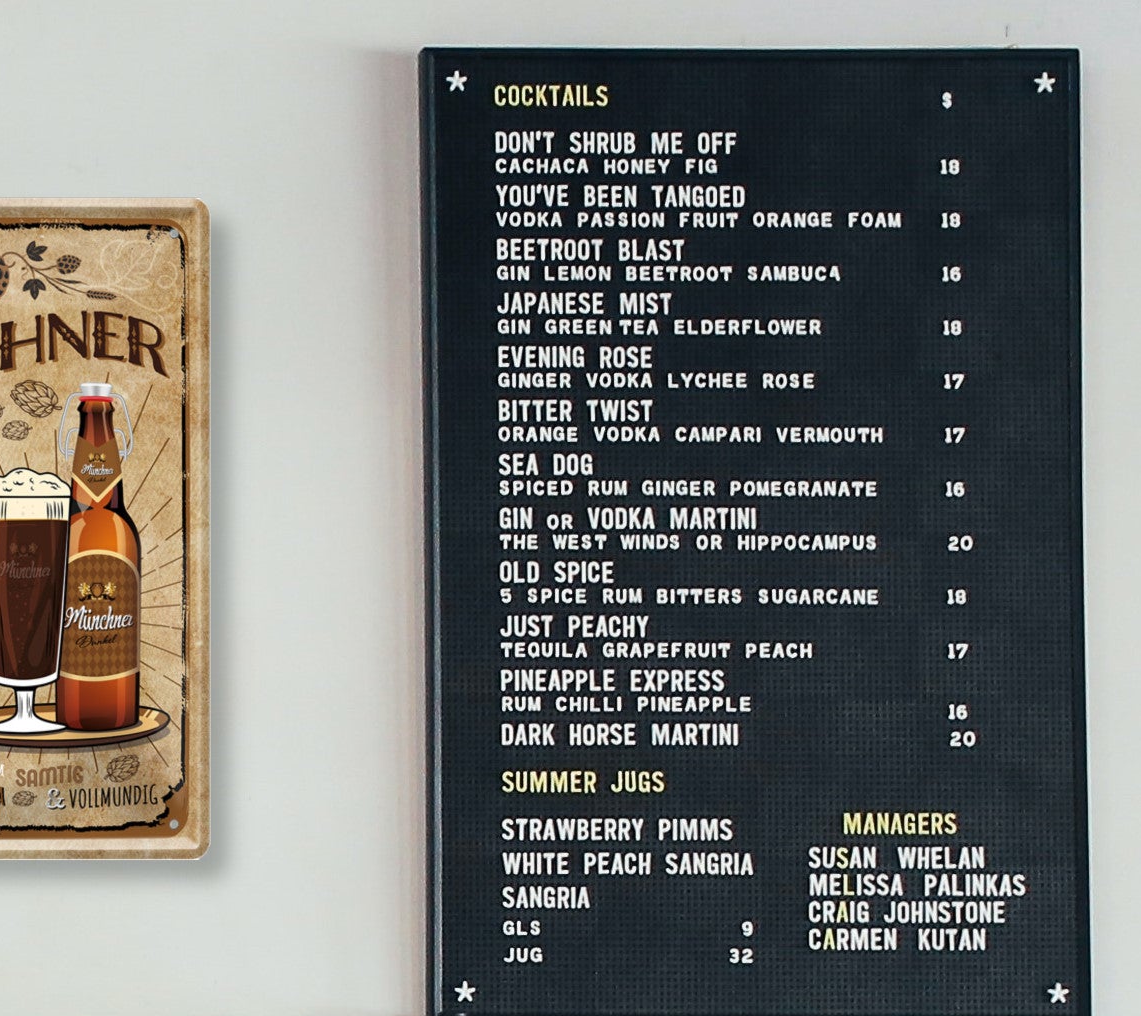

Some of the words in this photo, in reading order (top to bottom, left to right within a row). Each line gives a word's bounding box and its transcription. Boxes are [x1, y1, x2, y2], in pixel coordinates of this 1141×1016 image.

[494, 84, 609, 107] COCKTAILS
[494, 130, 555, 154] DON'T
[569, 131, 636, 155] SHRUB
[650, 131, 683, 155] ME
[697, 131, 737, 155] OFF
[495, 157, 589, 175] CACHACA
[603, 158, 671, 175] HONEY
[685, 158, 718, 175] FIG
[940, 158, 960, 175] 18
[495, 183, 569, 208] YOU'VE
[583, 184, 638, 208] BEEN
[650, 184, 746, 209] TANGOED
[495, 211, 563, 228] VODKA
[577, 211, 665, 229] PASSION
[679, 211, 739, 229] FRUIT
[752, 211, 833, 229] ORANGE
[847, 211, 902, 229] FOAM
[941, 212, 961, 229] 18
[496, 238, 604, 262] BEETROOT
[618, 238, 685, 262] BLAST
[496, 264, 530, 282] GIN
[544, 265, 612, 282] LEMON
[625, 265, 733, 282] BEETROOT
[941, 266, 962, 283] 16
[496, 291, 605, 315] JAPANESE
[619, 292, 672, 316] MIST
[497, 318, 531, 335] GIN
[544, 318, 612, 336] GREEN
[618, 319, 659, 336] TEA
[673, 318, 822, 336] ELDERFLOWER
[942, 319, 962, 336] 18
[497, 345, 585, 369] EVENING
[599, 345, 653, 370] ROSE
[498, 399, 573, 423] BITTER
[585, 399, 654, 423] TWIST
[498, 452, 539, 476] SEA
[552, 453, 594, 476] DOG
[499, 506, 533, 530] GIN
[587, 506, 656, 530] VODKA
[669, 506, 757, 531] MARTINI
[499, 533, 539, 551] THE
[552, 533, 608, 551] WEST
[619, 533, 680, 551] WINDS
[737, 534, 877, 552] HIPPOCAMPUS
[947, 535, 974, 552] 20
[499, 560, 540, 584] OLD
[553, 560, 615, 584] SPICE
[499, 587, 512, 604] 5
[527, 587, 587, 605] SPICE
[602, 587, 643, 605] RUM
[656, 587, 743, 605] BITTERS
[758, 588, 879, 606] SUGARCANE
[946, 588, 967, 605] 18
[64, 606, 134, 631] Münchner
[499, 614, 554, 638] JUST
[567, 614, 649, 638] PEACHY
[500, 641, 588, 659] TEQUILA
[602, 641, 731, 659] GRAPEFRUIT
[745, 642, 813, 659] PEACH
[947, 642, 969, 660] 17
[500, 668, 616, 692] PINEAPPLE
[630, 669, 725, 693] EXPRESS
[501, 722, 555, 747] DARK
[569, 722, 637, 747] HORSE
[651, 722, 739, 747] MARTINI
[949, 730, 977, 748] 20
[15, 763, 84, 787] SAMTIG
[501, 770, 597, 794] SUMMER
[610, 770, 665, 793] JUGS
[69, 785, 159, 809] VOLLMUNDIG
[501, 817, 644, 842] STRAWBERRY
[658, 818, 734, 842] PIMMS
[843, 812, 958, 836] MANAGERS
[502, 851, 570, 876] WHITE
[583, 851, 652, 876] PEACH
[664, 852, 754, 876] SANGRIA
[808, 845, 877, 870] SUSAN
[897, 845, 985, 870] WHELAN
[809, 872, 904, 897] MELISSA
[924, 873, 1027, 898] PALINKAS
[502, 885, 591, 910] SANGRIA
[808, 900, 870, 924] CRAIG
[883, 900, 1006, 925] JOHNSTONE
[502, 919, 541, 936] GLS
[741, 920, 754, 937] 9
[808, 927, 898, 951] CARMEN
[917, 927, 987, 952] KUTAN
[503, 947, 543, 963] JUG
[729, 947, 754, 964] 32
